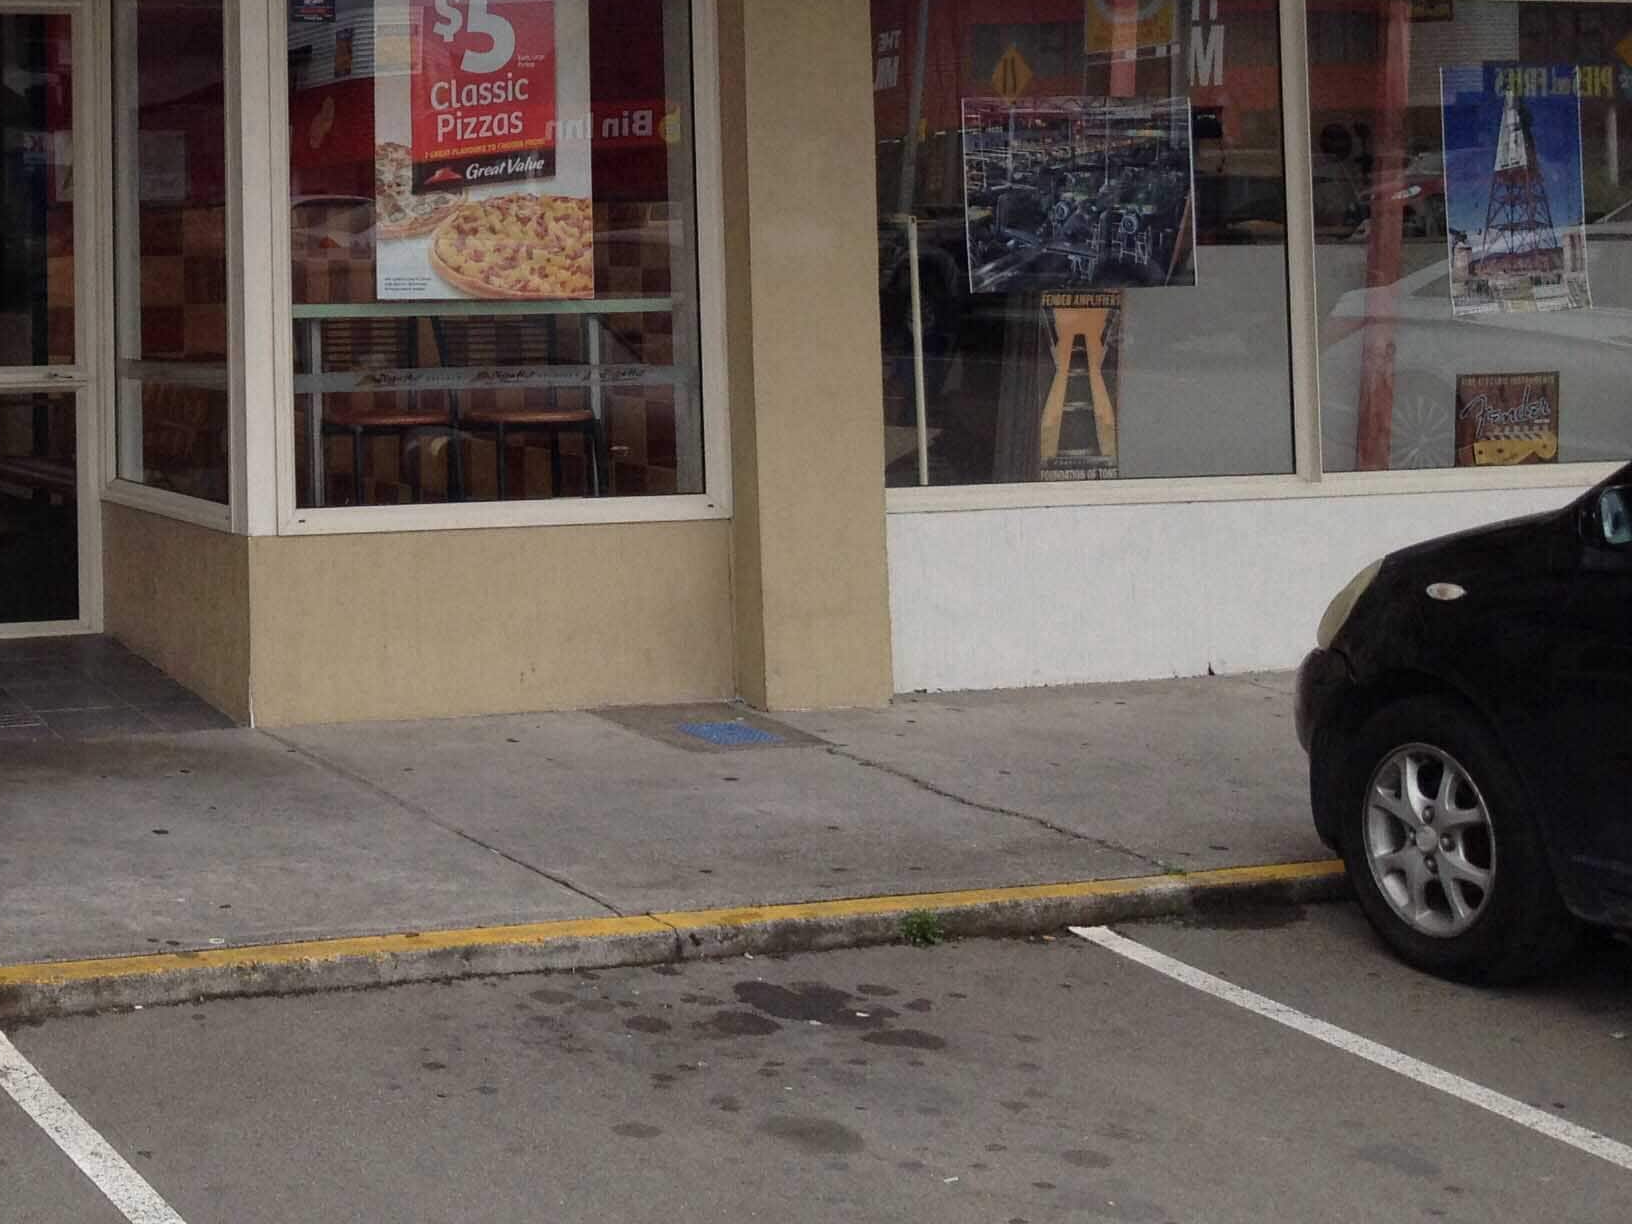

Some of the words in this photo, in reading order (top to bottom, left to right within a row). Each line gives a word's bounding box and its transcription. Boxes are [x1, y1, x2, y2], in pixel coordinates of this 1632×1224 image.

[430, 72, 529, 110] Classic
[436, 111, 524, 144] Pizzas
[465, 159, 506, 180] Great
[506, 156, 545, 175] Value
[1459, 384, 1552, 440] Fender
